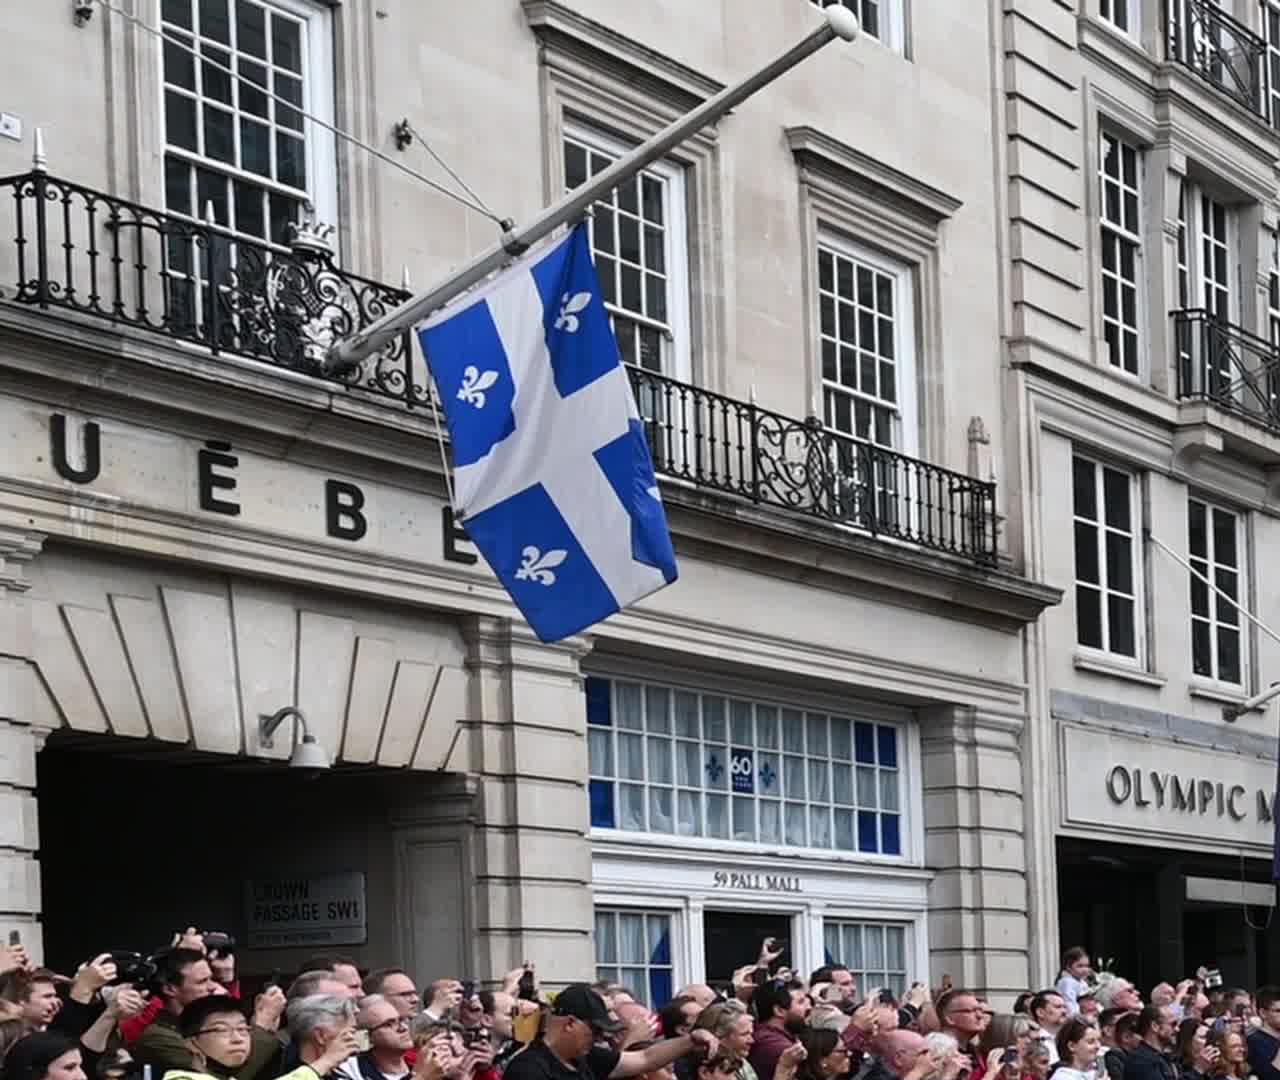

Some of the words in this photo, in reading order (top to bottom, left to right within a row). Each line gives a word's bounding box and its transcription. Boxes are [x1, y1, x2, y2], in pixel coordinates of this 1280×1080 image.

[730, 755, 751, 775] 60
[1105, 765, 1247, 822] OLYMPIC
[712, 871, 729, 889] 59
[730, 872, 763, 889] PALL
[765, 874, 803, 893] MALL
[254, 902, 320, 921] PASSAGE
